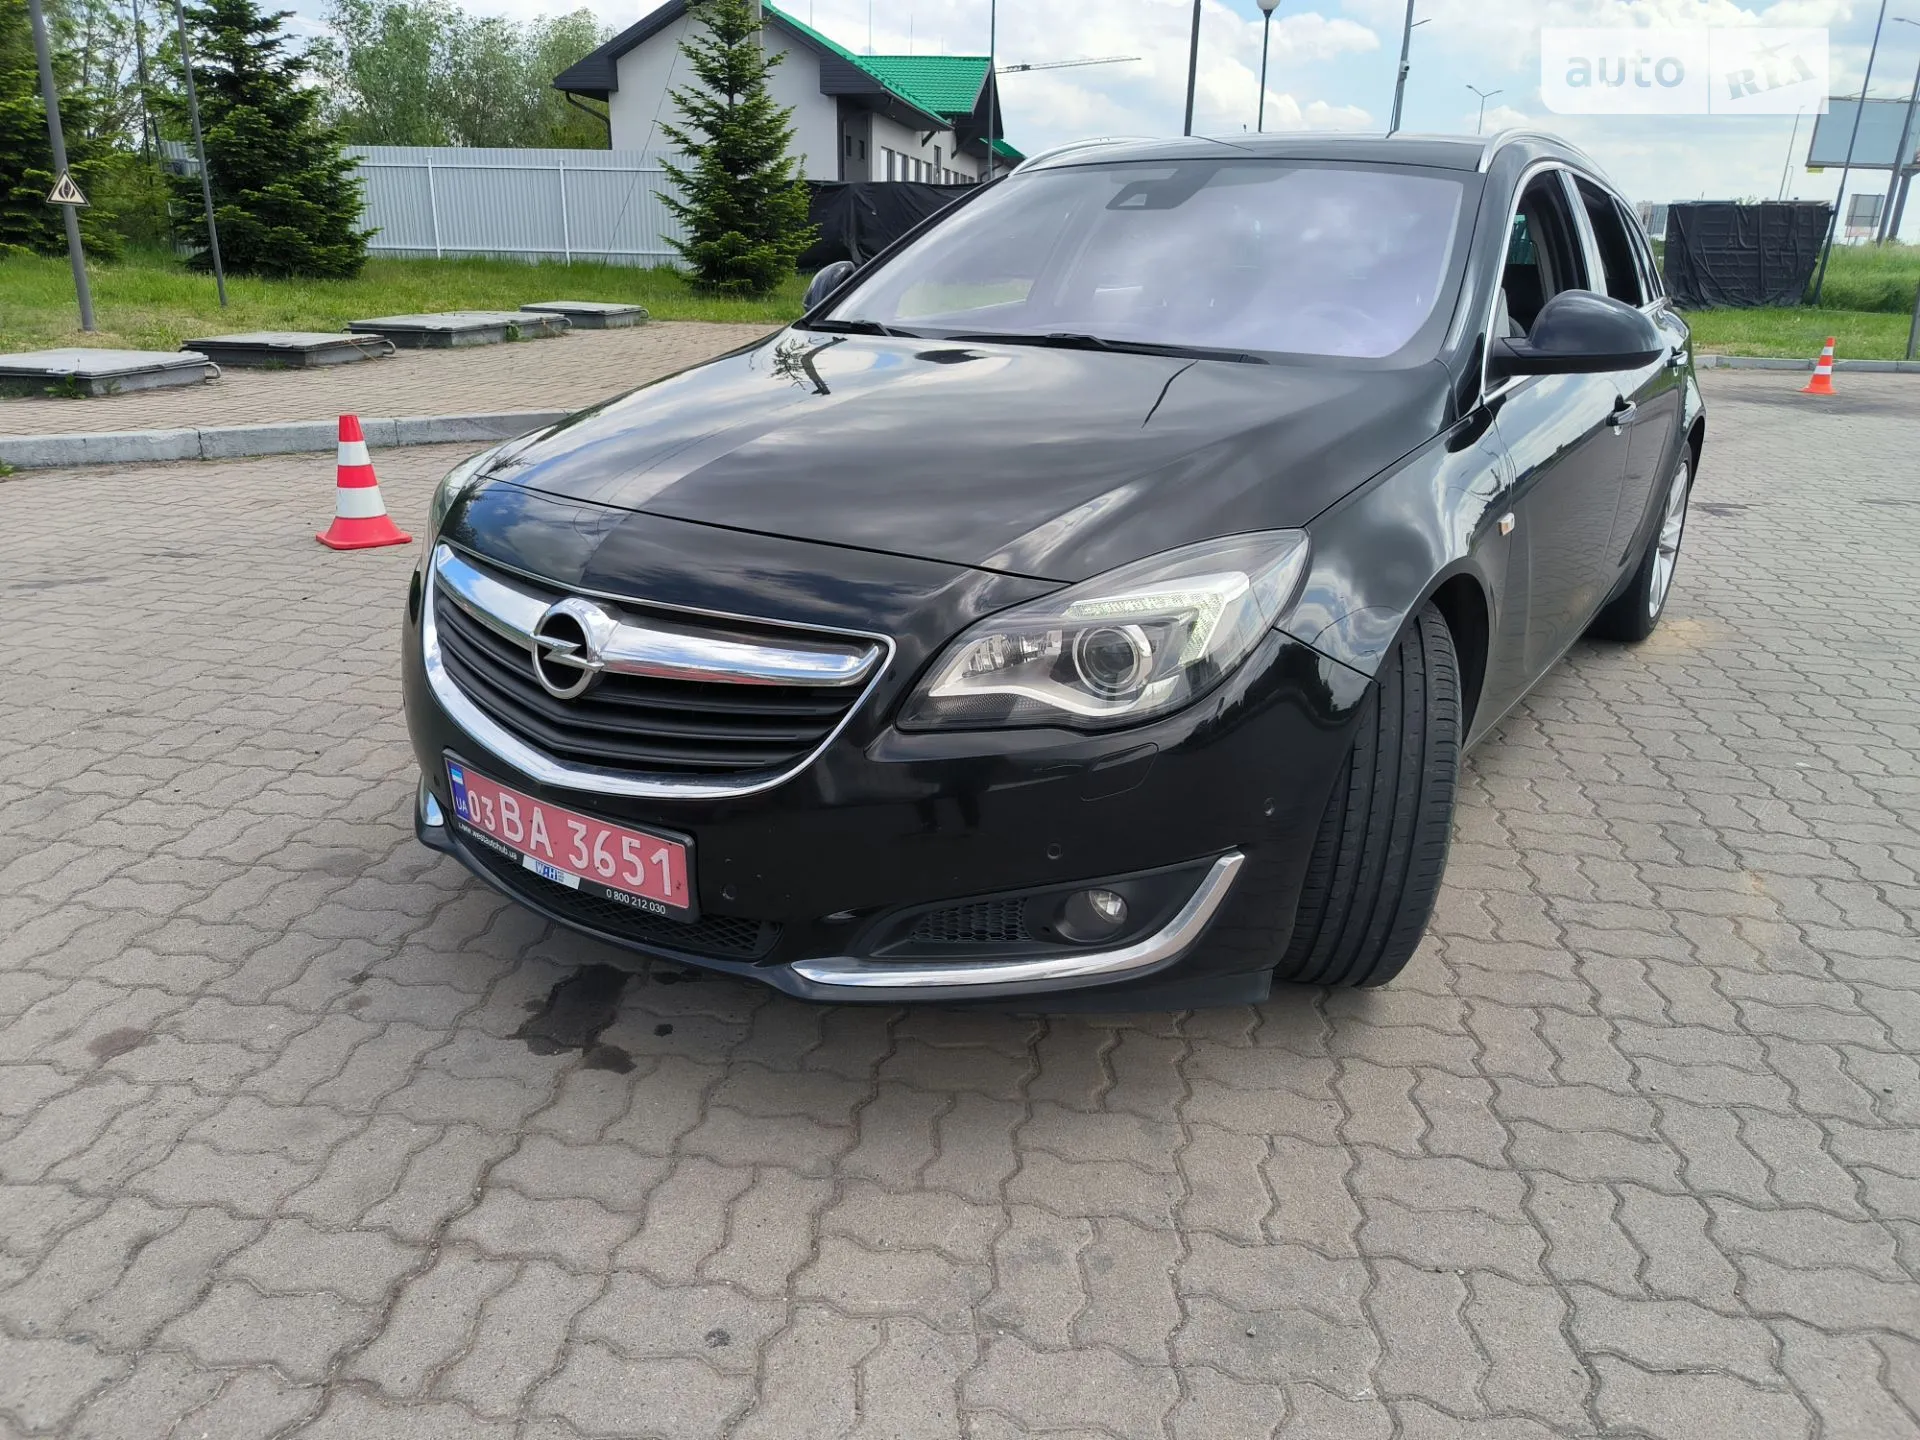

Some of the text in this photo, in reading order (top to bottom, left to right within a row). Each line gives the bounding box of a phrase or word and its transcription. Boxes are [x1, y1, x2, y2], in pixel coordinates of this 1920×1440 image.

[456, 796, 468, 814] UA
[568, 819, 671, 896] 3651
[606, 889, 665, 914] 0 800 212 030
